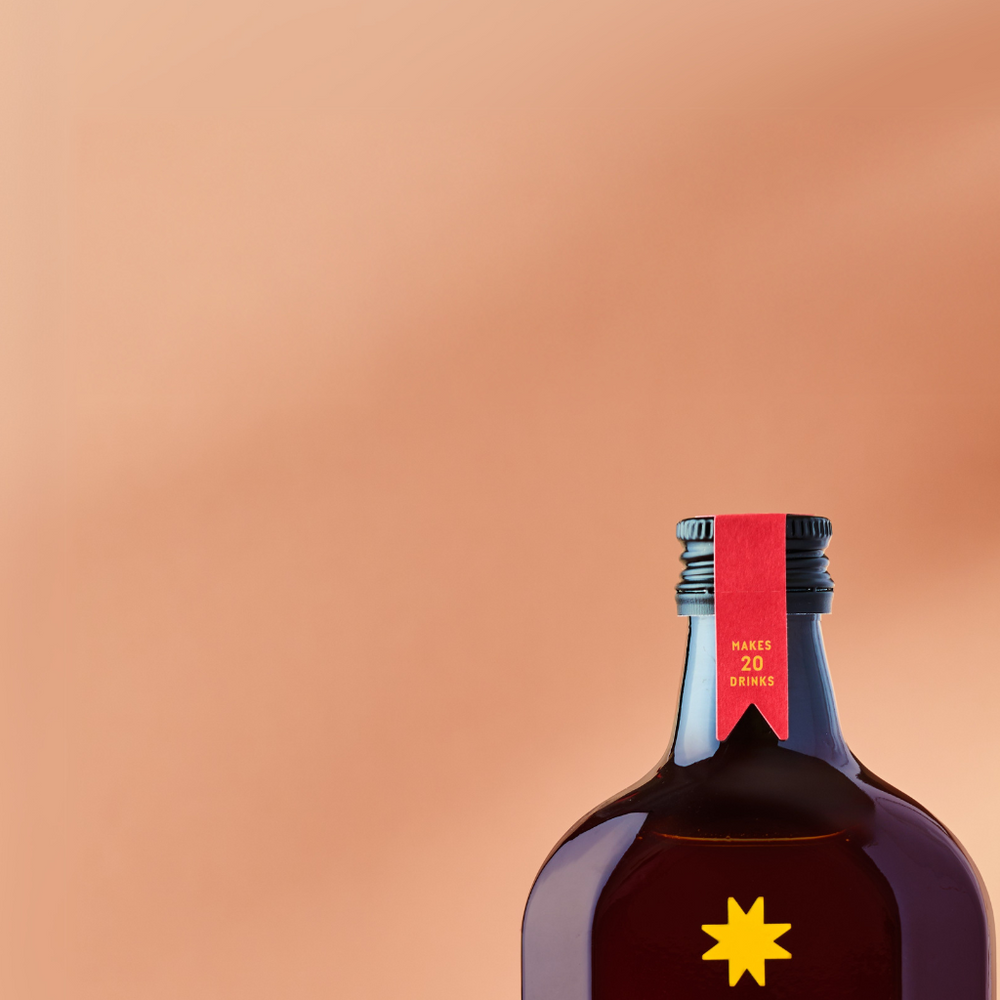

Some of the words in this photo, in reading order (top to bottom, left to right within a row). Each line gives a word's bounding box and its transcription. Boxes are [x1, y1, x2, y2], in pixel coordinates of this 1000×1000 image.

[731, 640, 772, 652] MAKES
[740, 655, 764, 672] 20
[729, 676, 775, 687] DRINKS
